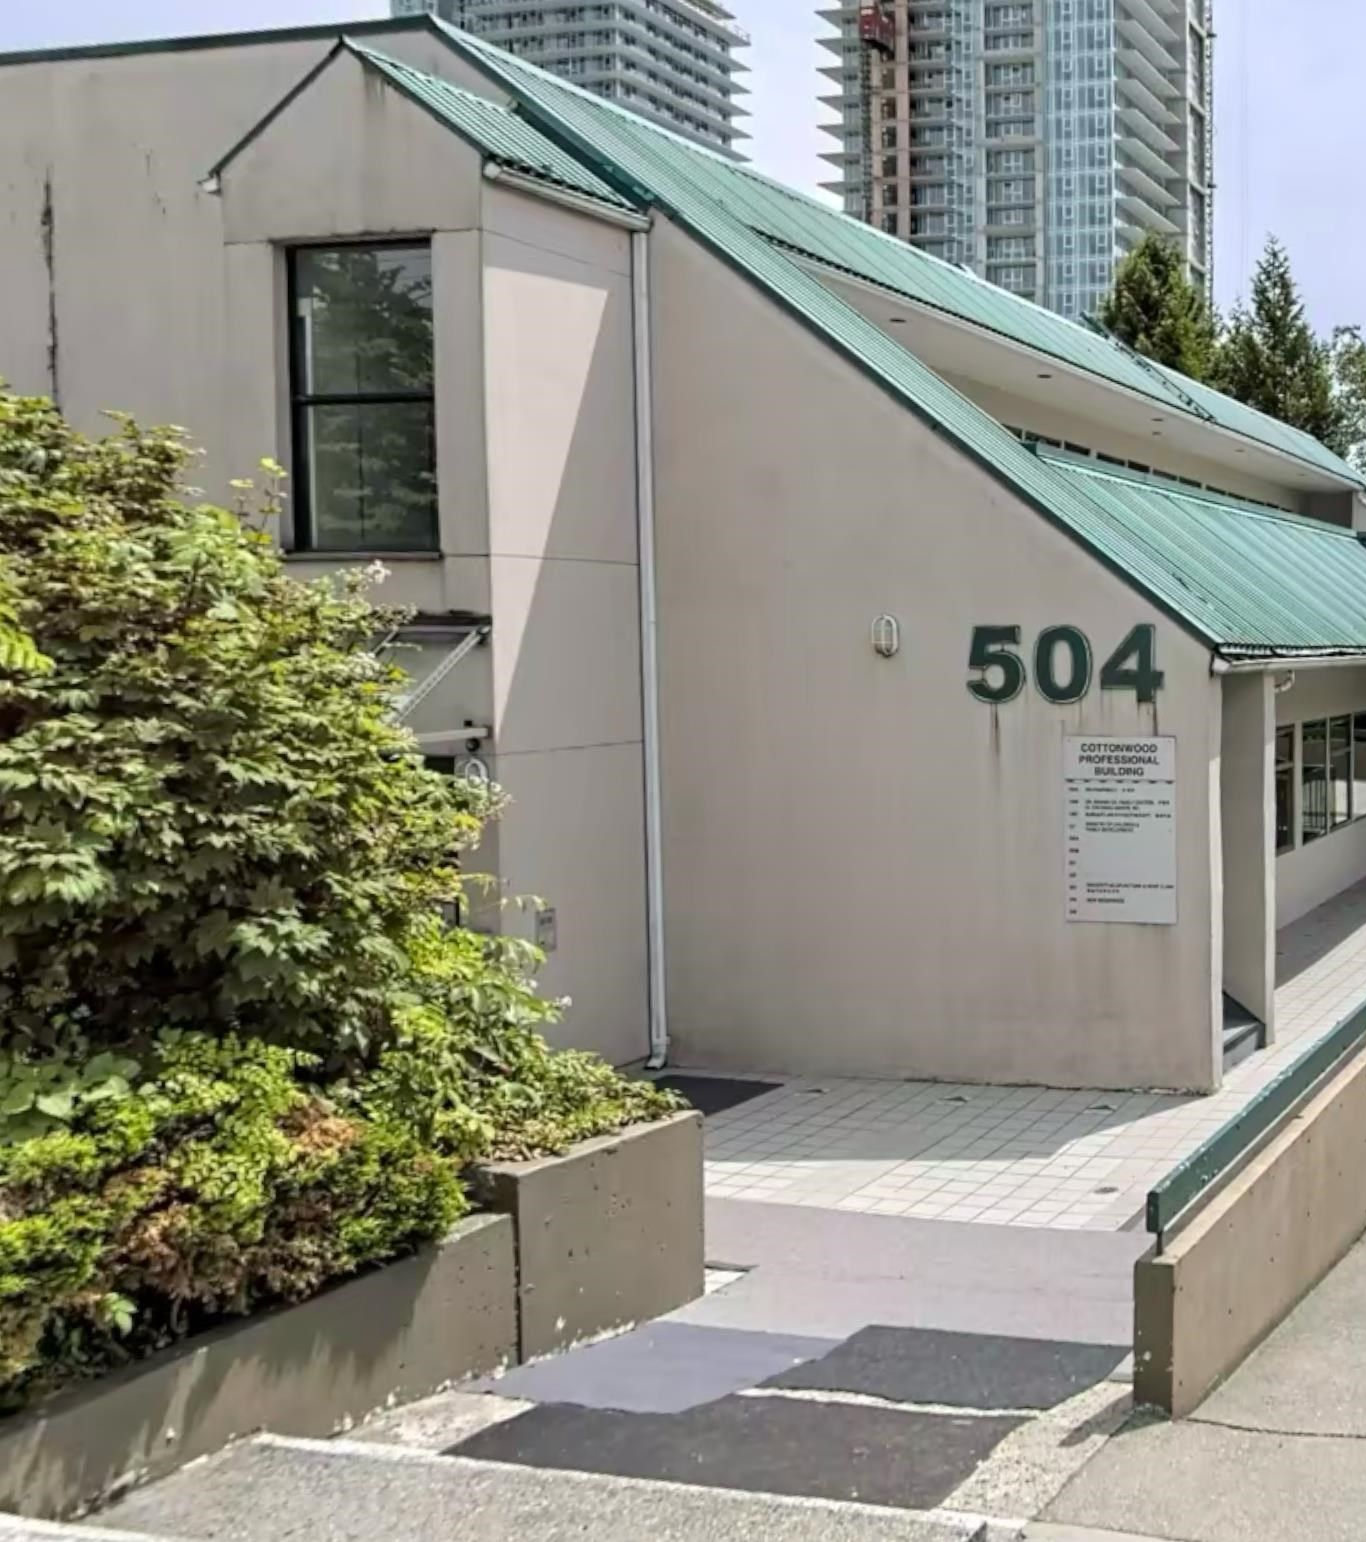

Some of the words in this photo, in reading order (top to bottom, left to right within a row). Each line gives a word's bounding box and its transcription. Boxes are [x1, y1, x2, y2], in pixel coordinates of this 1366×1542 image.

[966, 624, 1164, 704] 504
[1080, 743, 1158, 753] COTTONWOOD
[1078, 754, 1159, 765] PROFESSIONAL
[1094, 766, 1145, 776] BUILDING
